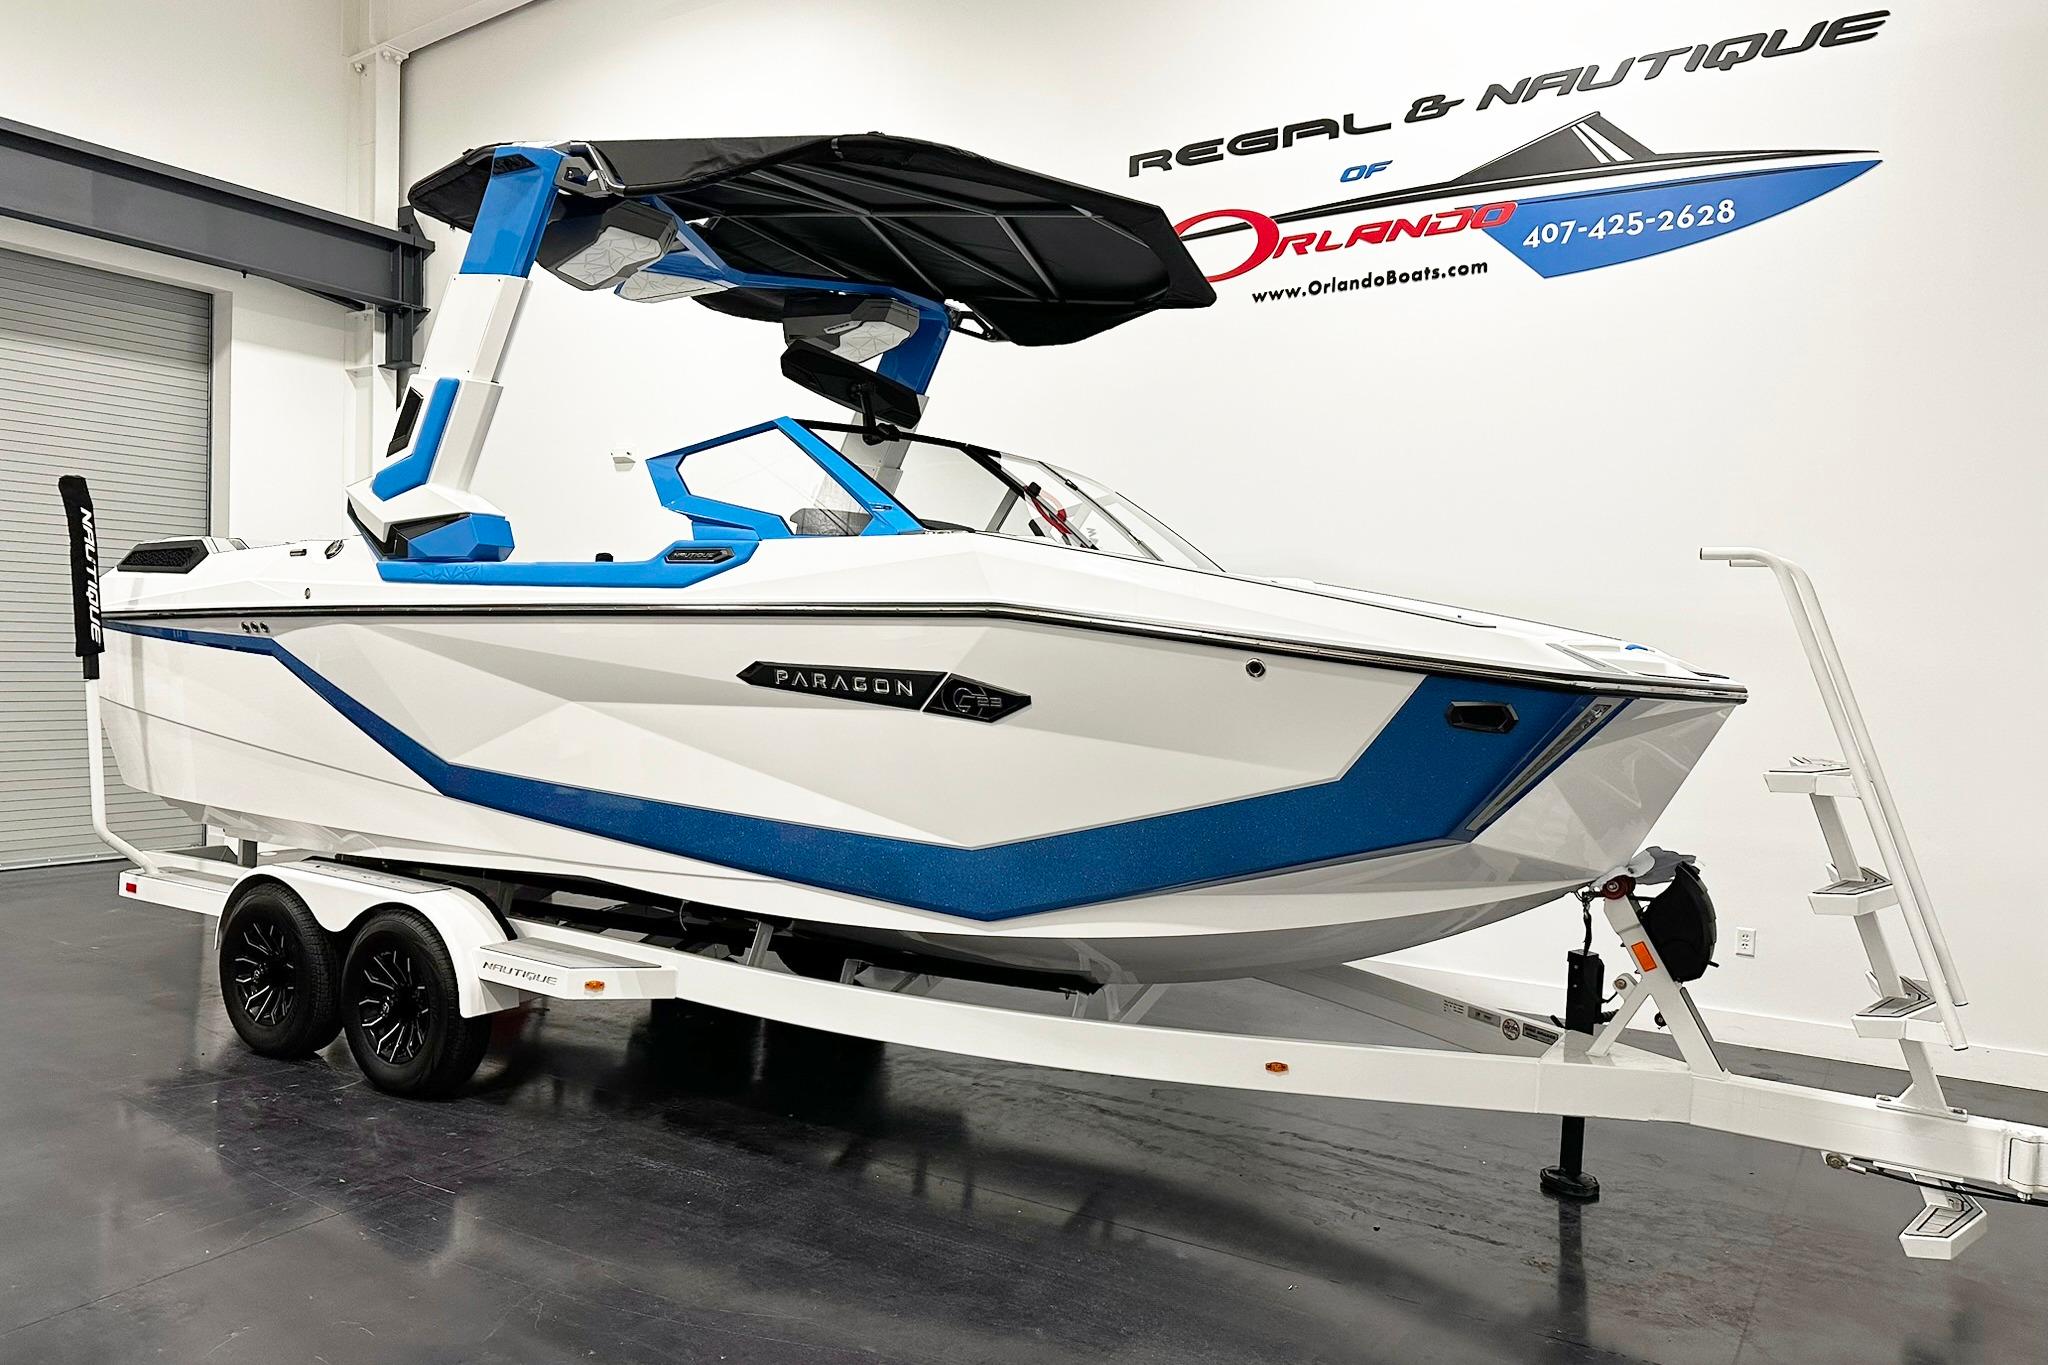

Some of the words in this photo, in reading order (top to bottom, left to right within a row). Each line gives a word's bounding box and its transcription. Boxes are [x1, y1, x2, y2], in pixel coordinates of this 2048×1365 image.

[1129, 113, 1392, 178] REGAL
[1404, 94, 1465, 123] &
[1475, 10, 1891, 111] NAUTIQUE
[1340, 159, 1393, 183] OF
[1174, 201, 1518, 283] ORLANDO
[1522, 198, 1737, 249] 407-425-2628
[1252, 260, 1489, 303] www.OrlandoBoats.com
[79, 506, 102, 645] NAUTIQUE
[673, 551, 716, 559] NAUTIQUE
[775, 669, 913, 697] PARAGON
[482, 960, 559, 986] NAUTIQUE
